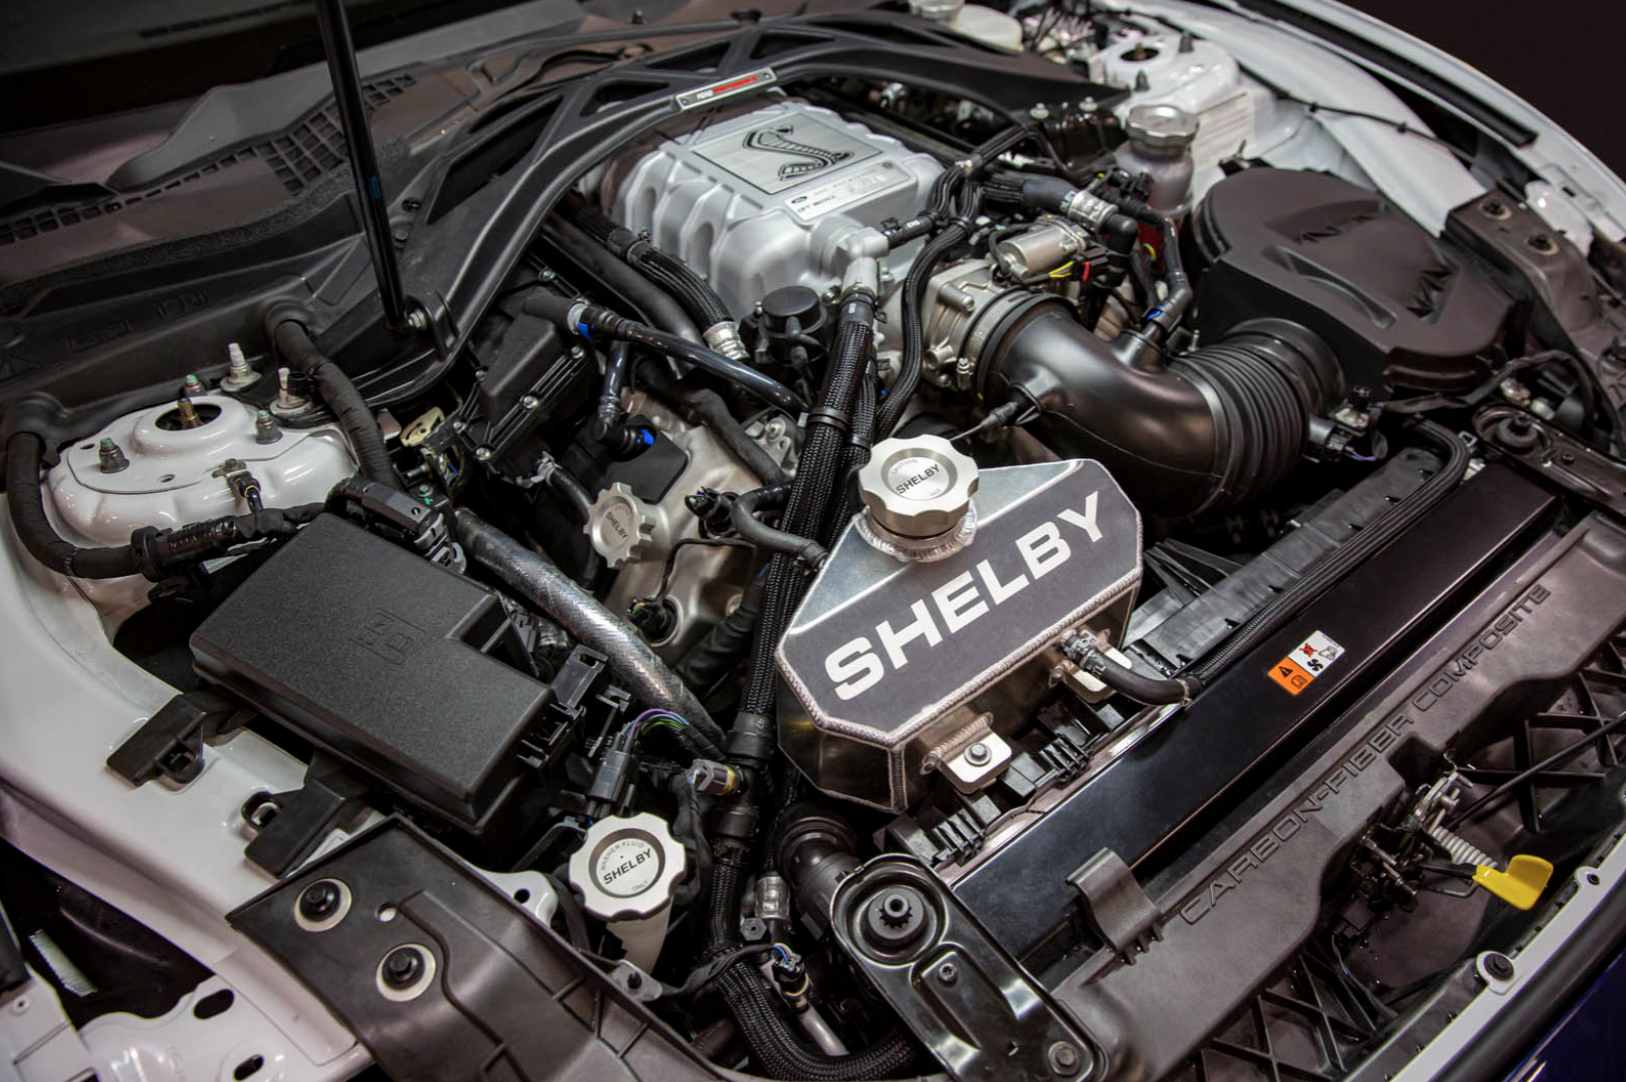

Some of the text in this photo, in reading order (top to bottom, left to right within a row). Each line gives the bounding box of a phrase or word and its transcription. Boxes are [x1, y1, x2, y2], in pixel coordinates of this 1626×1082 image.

[891, 459, 918, 475] CAUTION
[895, 463, 940, 495] SHELBY
[605, 511, 629, 539] SHELBY
[825, 491, 1103, 701] SHELBY
[1180, 583, 1551, 925] CARBON-FIBER COMPOSITE
[602, 840, 645, 871] WASHER FLUID
[603, 848, 652, 885] SHELBY
[632, 879, 649, 892] ONLY
